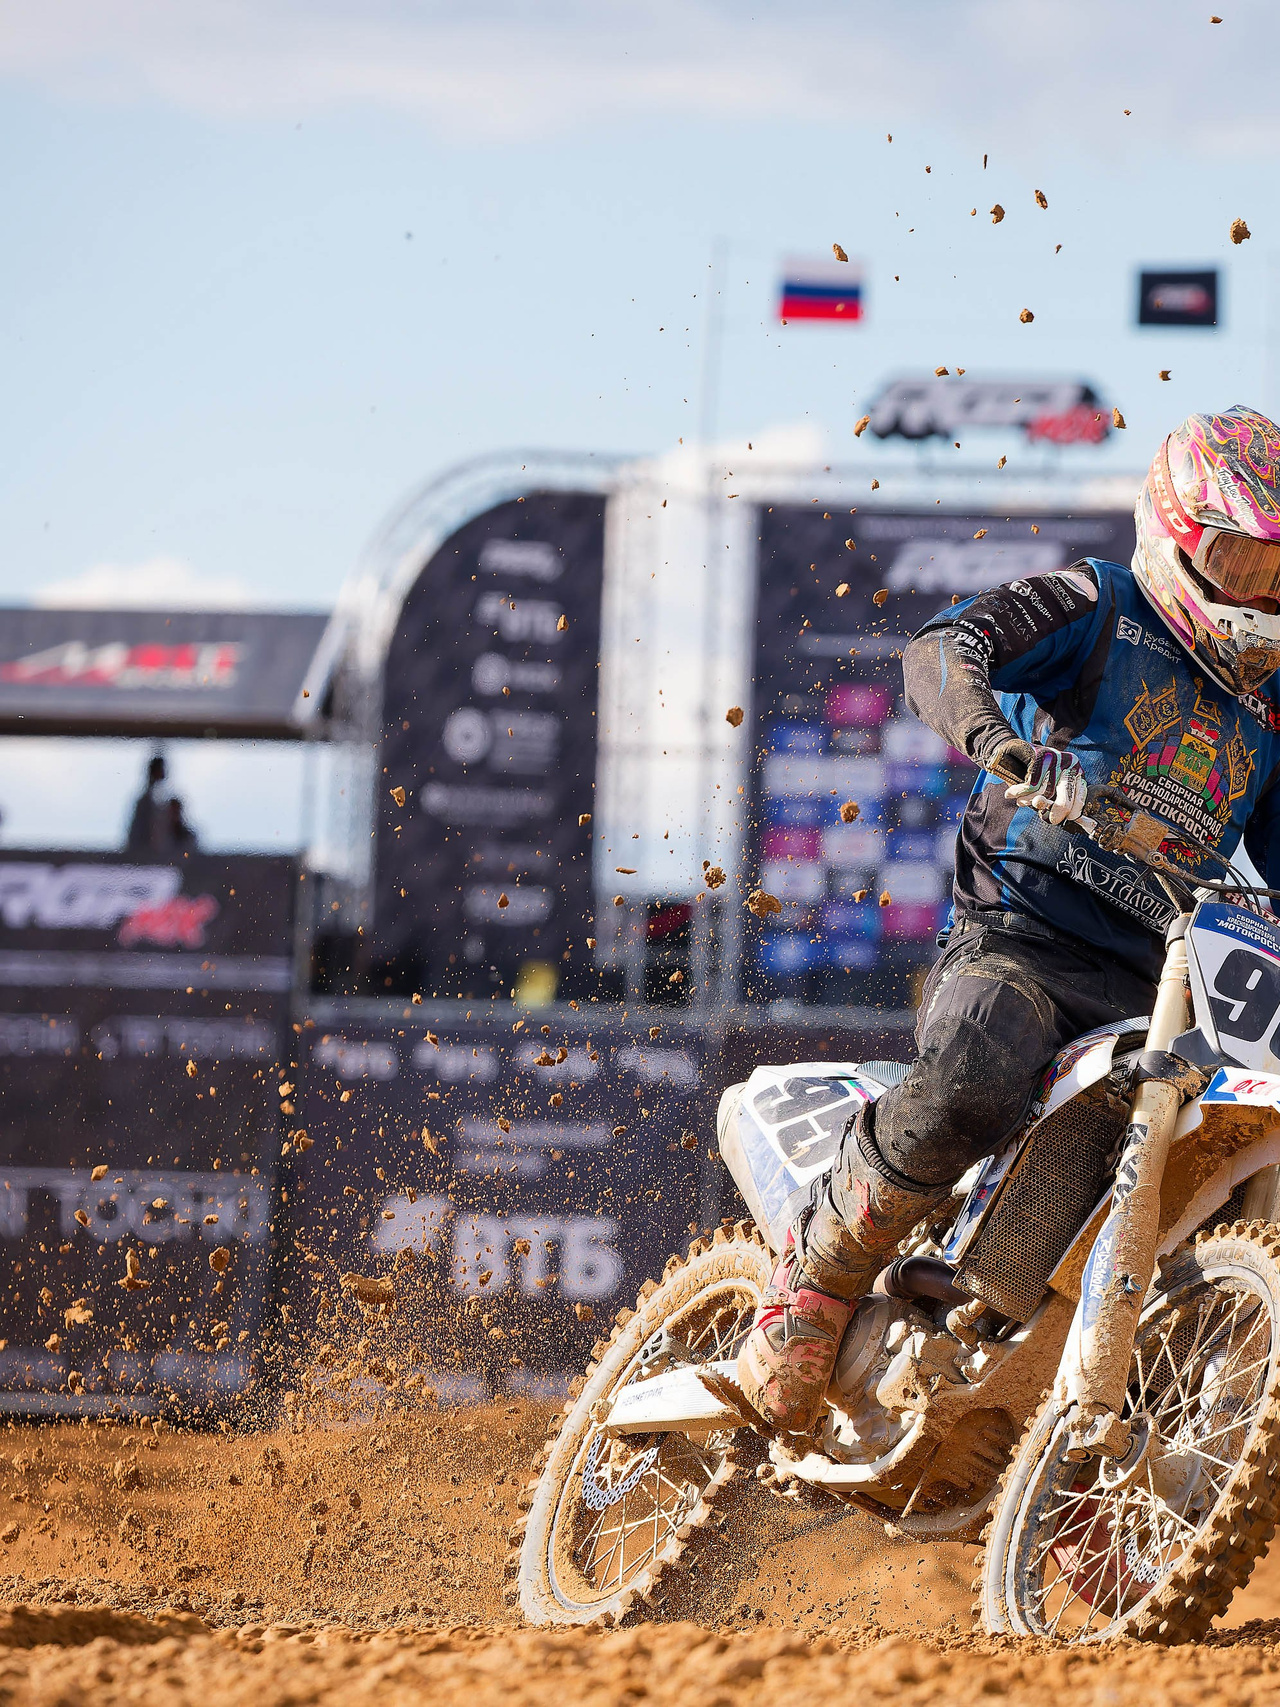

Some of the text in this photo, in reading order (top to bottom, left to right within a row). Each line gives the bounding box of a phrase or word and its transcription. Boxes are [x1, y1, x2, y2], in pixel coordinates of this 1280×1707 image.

[1142, 637, 1182, 665] Кредит
[1144, 630, 1182, 656] Кубань
[1121, 771, 1223, 839] КРАСНОДАРСКОГО КРАЯ
[1157, 776, 1204, 808] СБОРНАЯ
[1127, 788, 1209, 845] МОТОКРОСС
[1095, 869, 1166, 919] ЭТАЛОН
[1217, 920, 1280, 953] МОТОКРОСС
[1235, 914, 1270, 932] СБОРНАЯ
[449, 1213, 625, 1300] ВТБ
